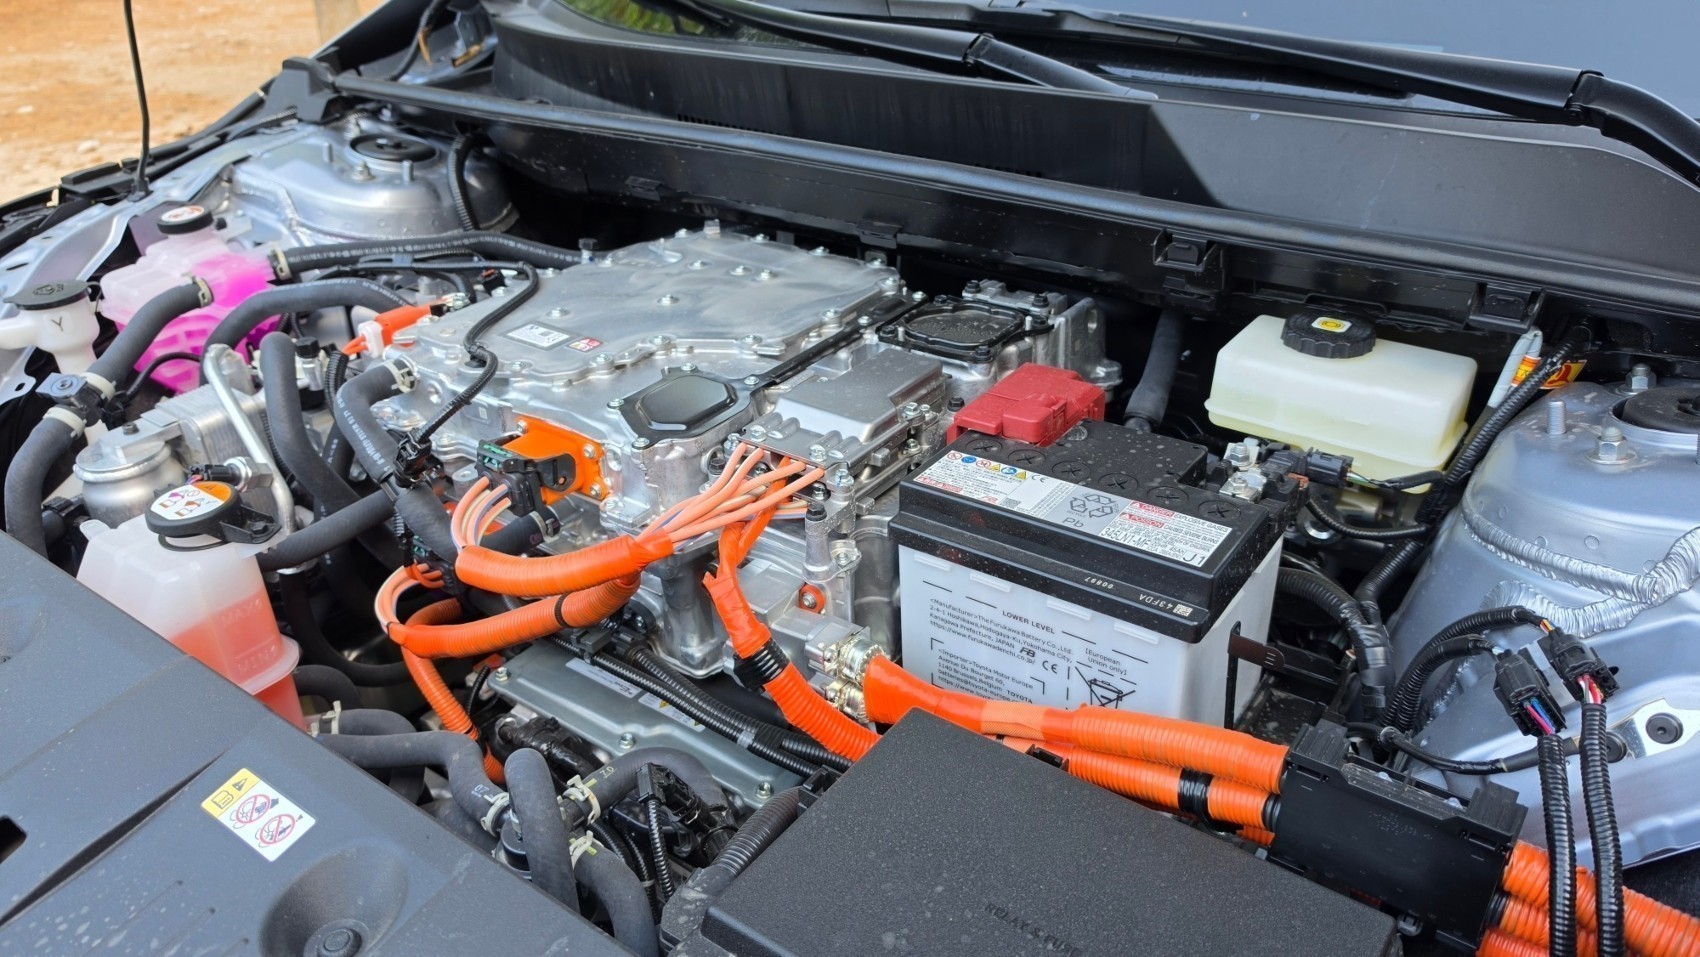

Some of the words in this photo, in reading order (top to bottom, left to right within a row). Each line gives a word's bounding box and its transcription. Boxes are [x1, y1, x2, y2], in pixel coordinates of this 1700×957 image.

[1062, 517, 1084, 528] Pb
[1172, 513, 1207, 526] EXPLOSIVE
[1206, 523, 1229, 532] GASES
[1100, 527, 1151, 549] 345LN1-MF
[1139, 593, 1173, 610] 43FDA
[929, 612, 958, 627] Kanagawa
[994, 636, 1014, 648] JAPAN
[1002, 610, 1029, 624] LOWER
[1031, 621, 1055, 634] LEVEL
[938, 654, 958, 667] Avenue
[960, 663, 968, 671] Du
[970, 667, 993, 681] Bourget
[1042, 660, 1058, 674] CE
[1088, 655, 1107, 668] Union
[993, 669, 1009, 680] Motor
[1011, 676, 1032, 690] Europe
[1006, 689, 1032, 704] TOYOTA
